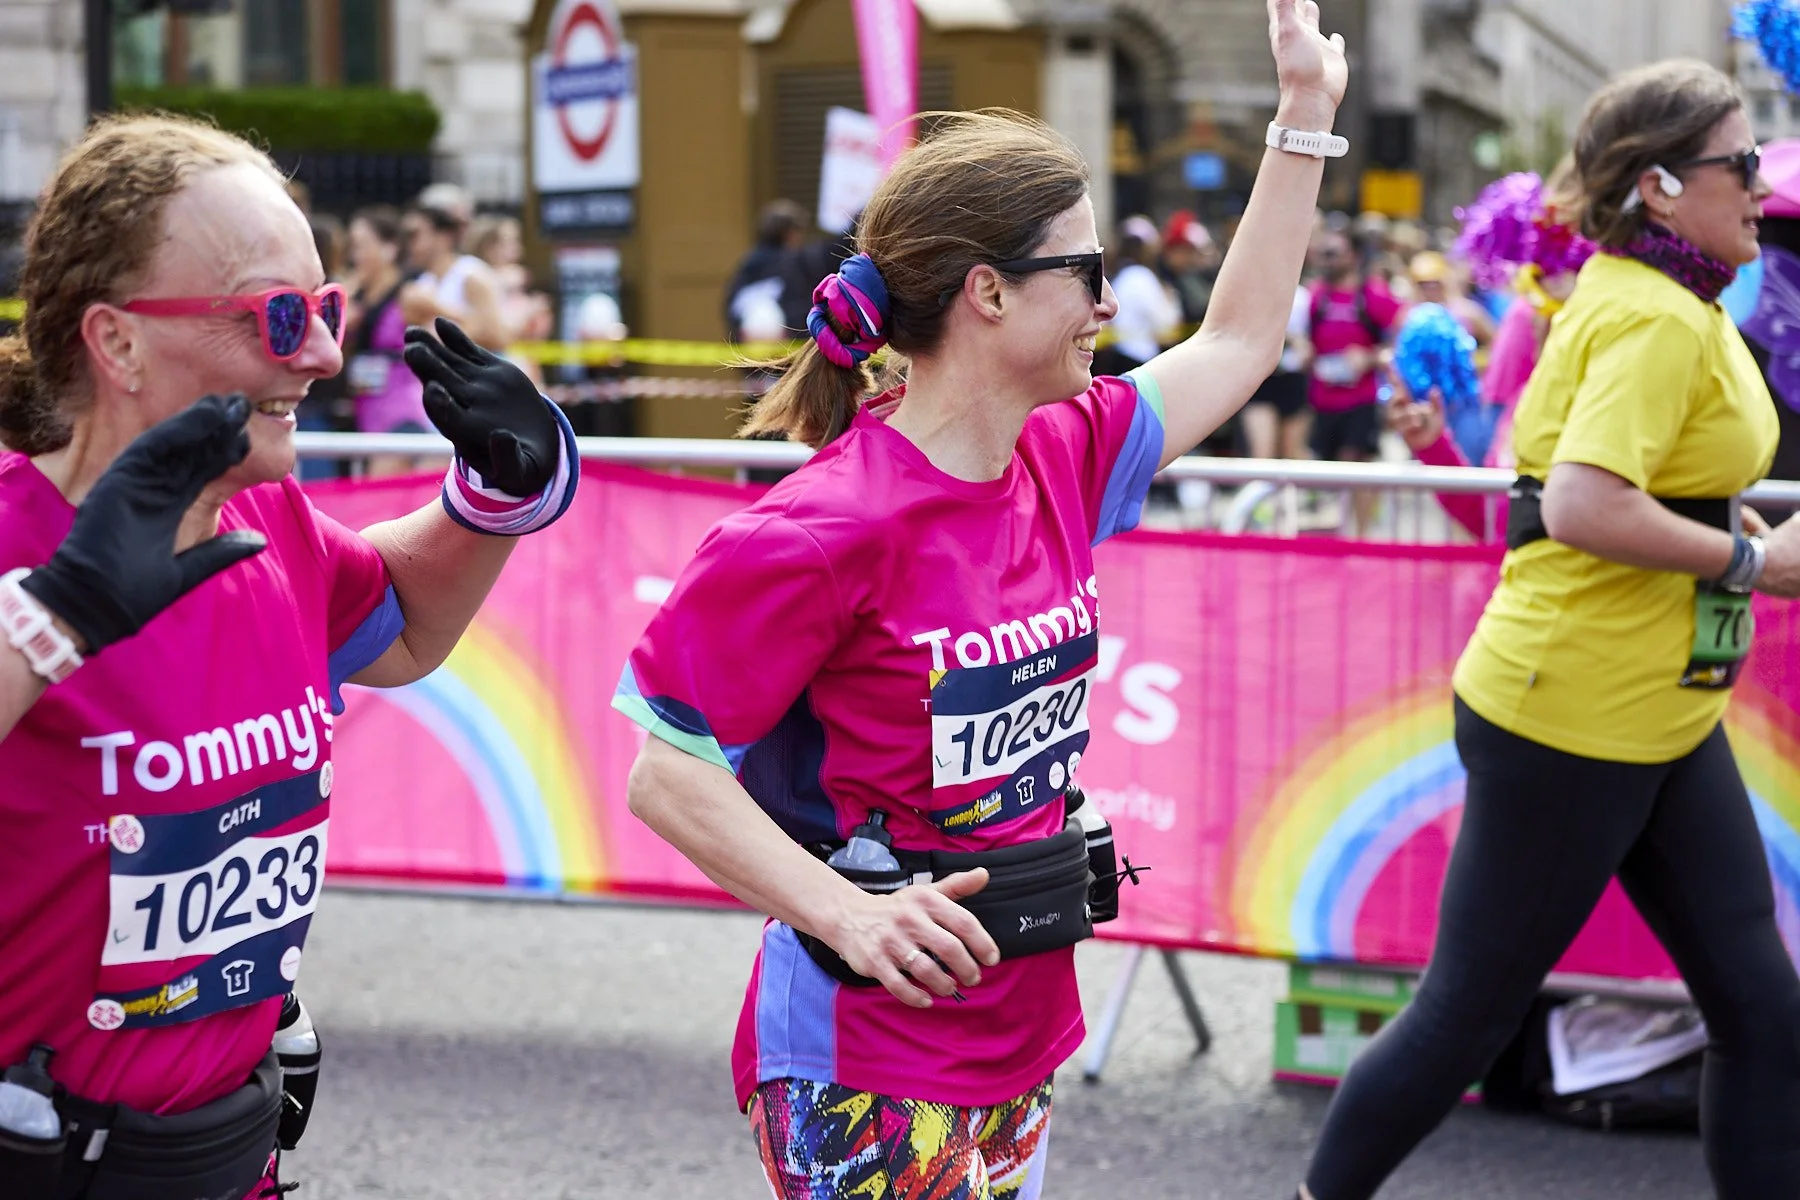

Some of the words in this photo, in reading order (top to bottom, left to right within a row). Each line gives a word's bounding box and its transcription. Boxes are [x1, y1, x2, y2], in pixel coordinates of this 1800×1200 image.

[1011, 655, 1057, 686] HELEN
[80, 685, 333, 796] Tommy's
[951, 678, 1087, 777] 10230
[218, 798, 261, 834] CATH
[135, 834, 319, 952] 10233
